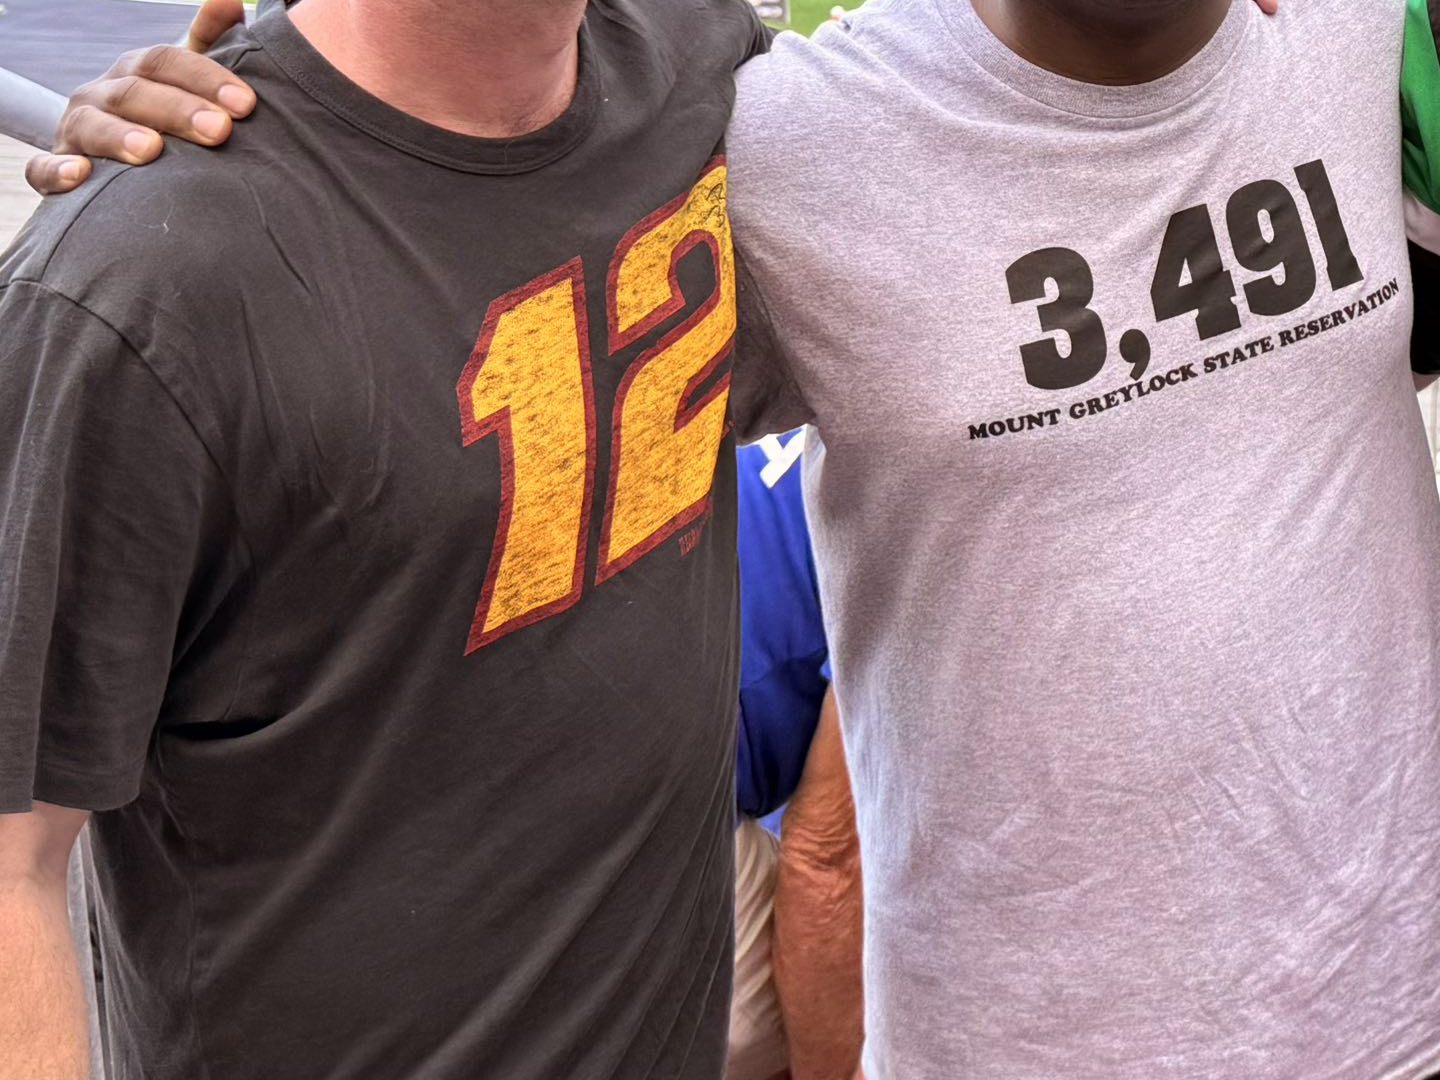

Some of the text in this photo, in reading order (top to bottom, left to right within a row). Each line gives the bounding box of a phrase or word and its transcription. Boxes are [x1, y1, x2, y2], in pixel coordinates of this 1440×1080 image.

[968, 277, 1400, 440] MOUNT GREYLOCK STATE RESERVATION
[1005, 158, 1365, 390] 3,491
[456, 154, 737, 656] 12
